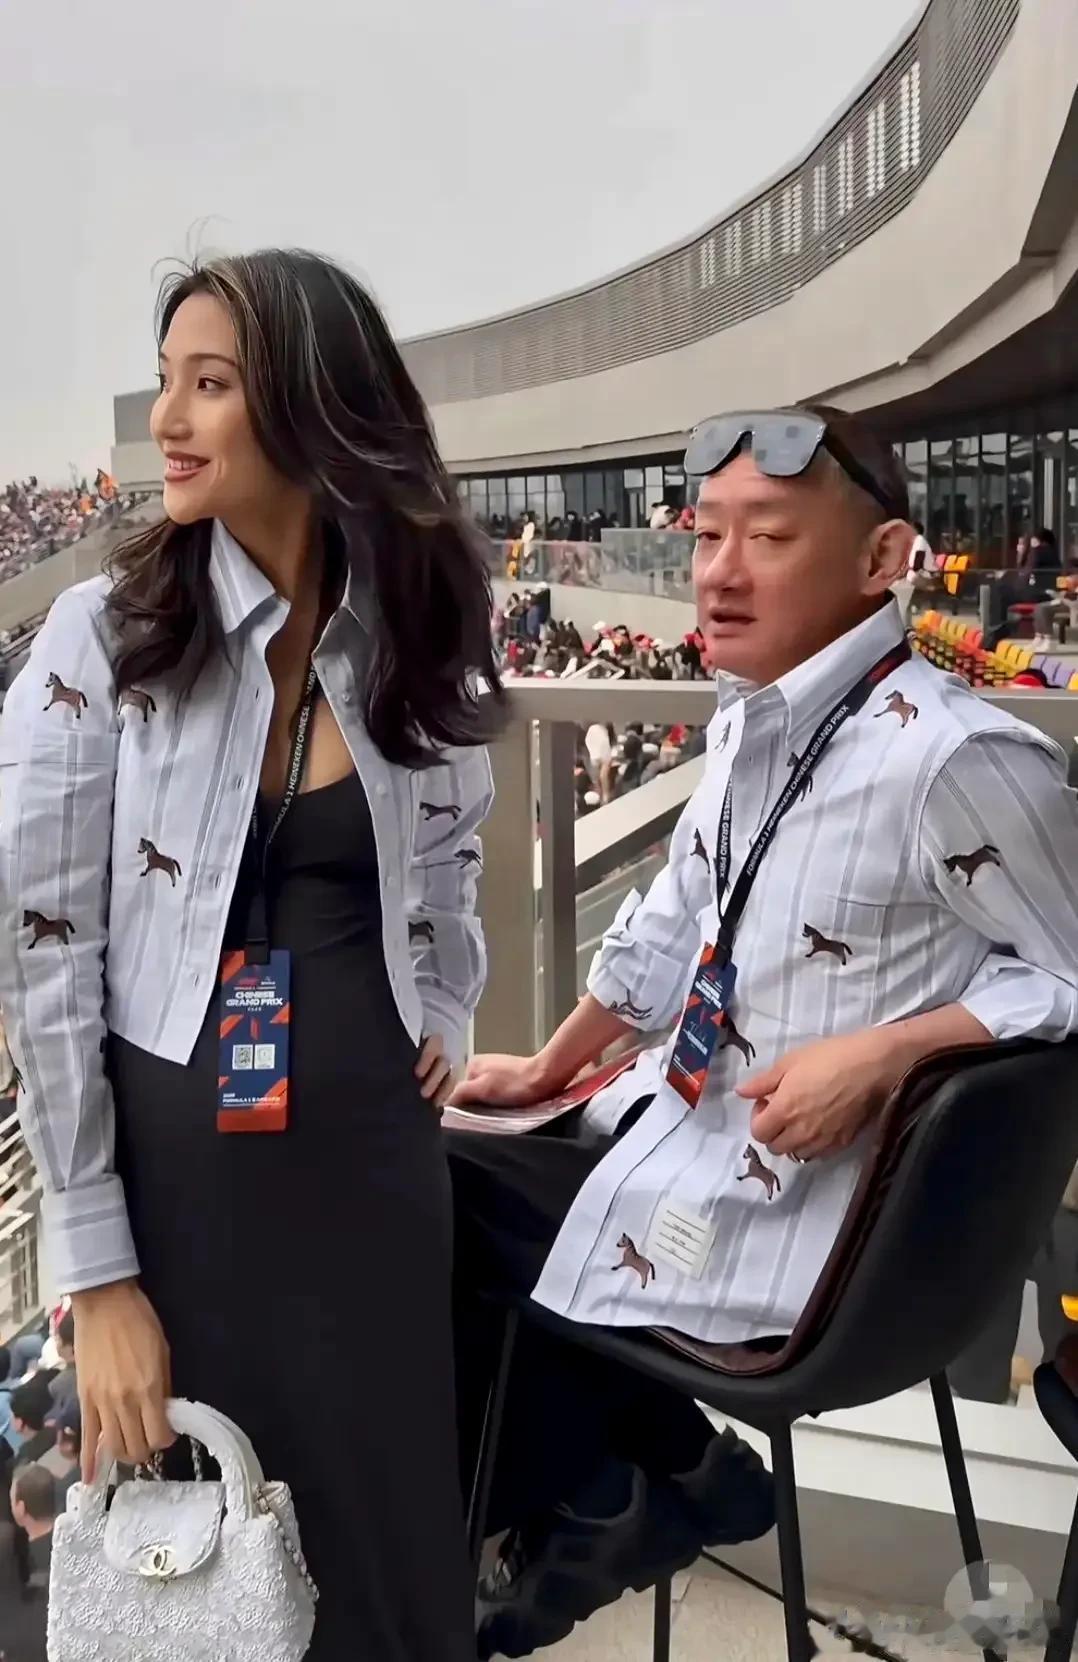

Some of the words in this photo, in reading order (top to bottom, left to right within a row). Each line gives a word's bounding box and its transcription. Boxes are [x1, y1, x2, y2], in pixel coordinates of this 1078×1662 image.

[746, 836, 766, 876] FORMULA
[766, 790, 792, 832] HEINEKEN
[790, 754, 813, 790] CHINESE
[810, 722, 833, 755] GRAND
[830, 704, 849, 725] PRIX
[720, 822, 729, 855] GRAND
[719, 857, 727, 878] PRIX
[226, 999, 260, 1007] GRAND
[260, 998, 283, 1006] PRIX
